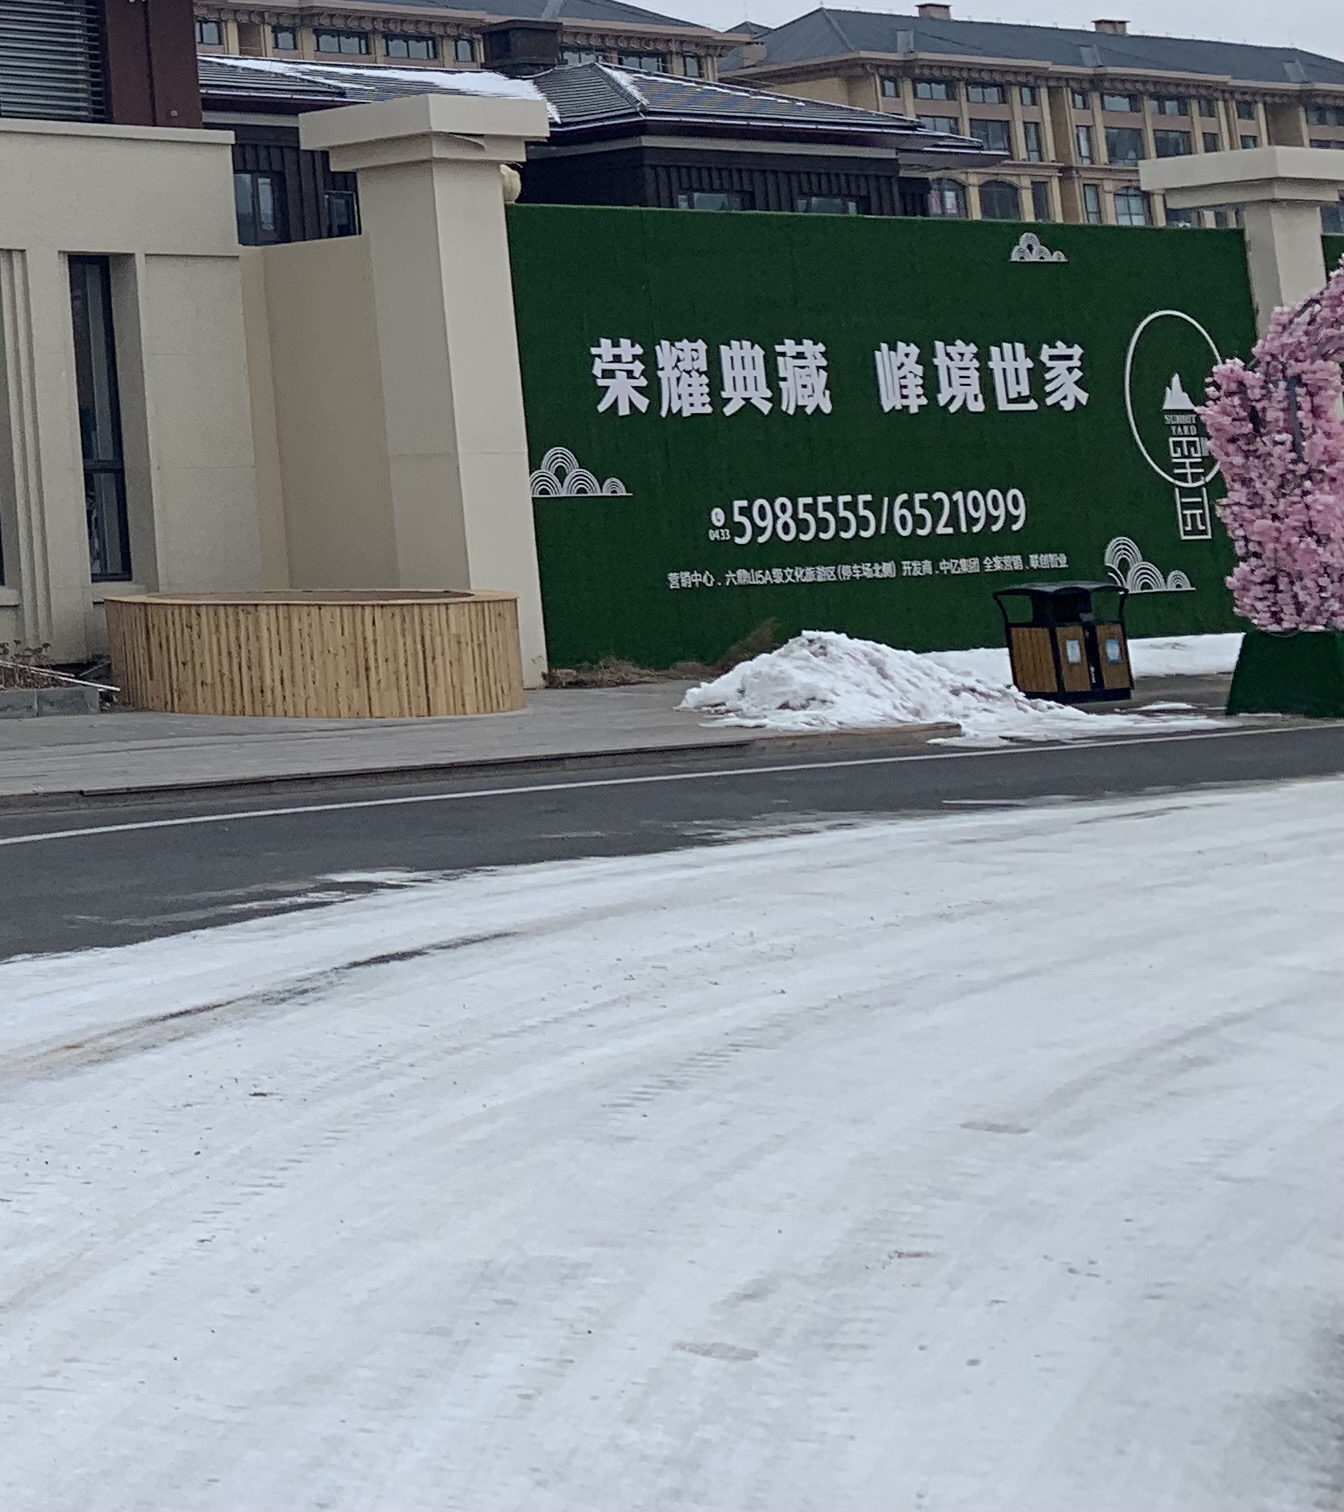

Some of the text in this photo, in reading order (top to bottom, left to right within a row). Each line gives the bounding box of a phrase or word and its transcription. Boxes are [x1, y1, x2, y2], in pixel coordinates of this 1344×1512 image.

[590, 337, 1090, 418] 荣耀典藏 峰境世家
[708, 528, 731, 541] 0433
[732, 488, 1027, 545] 5985555/6521999
